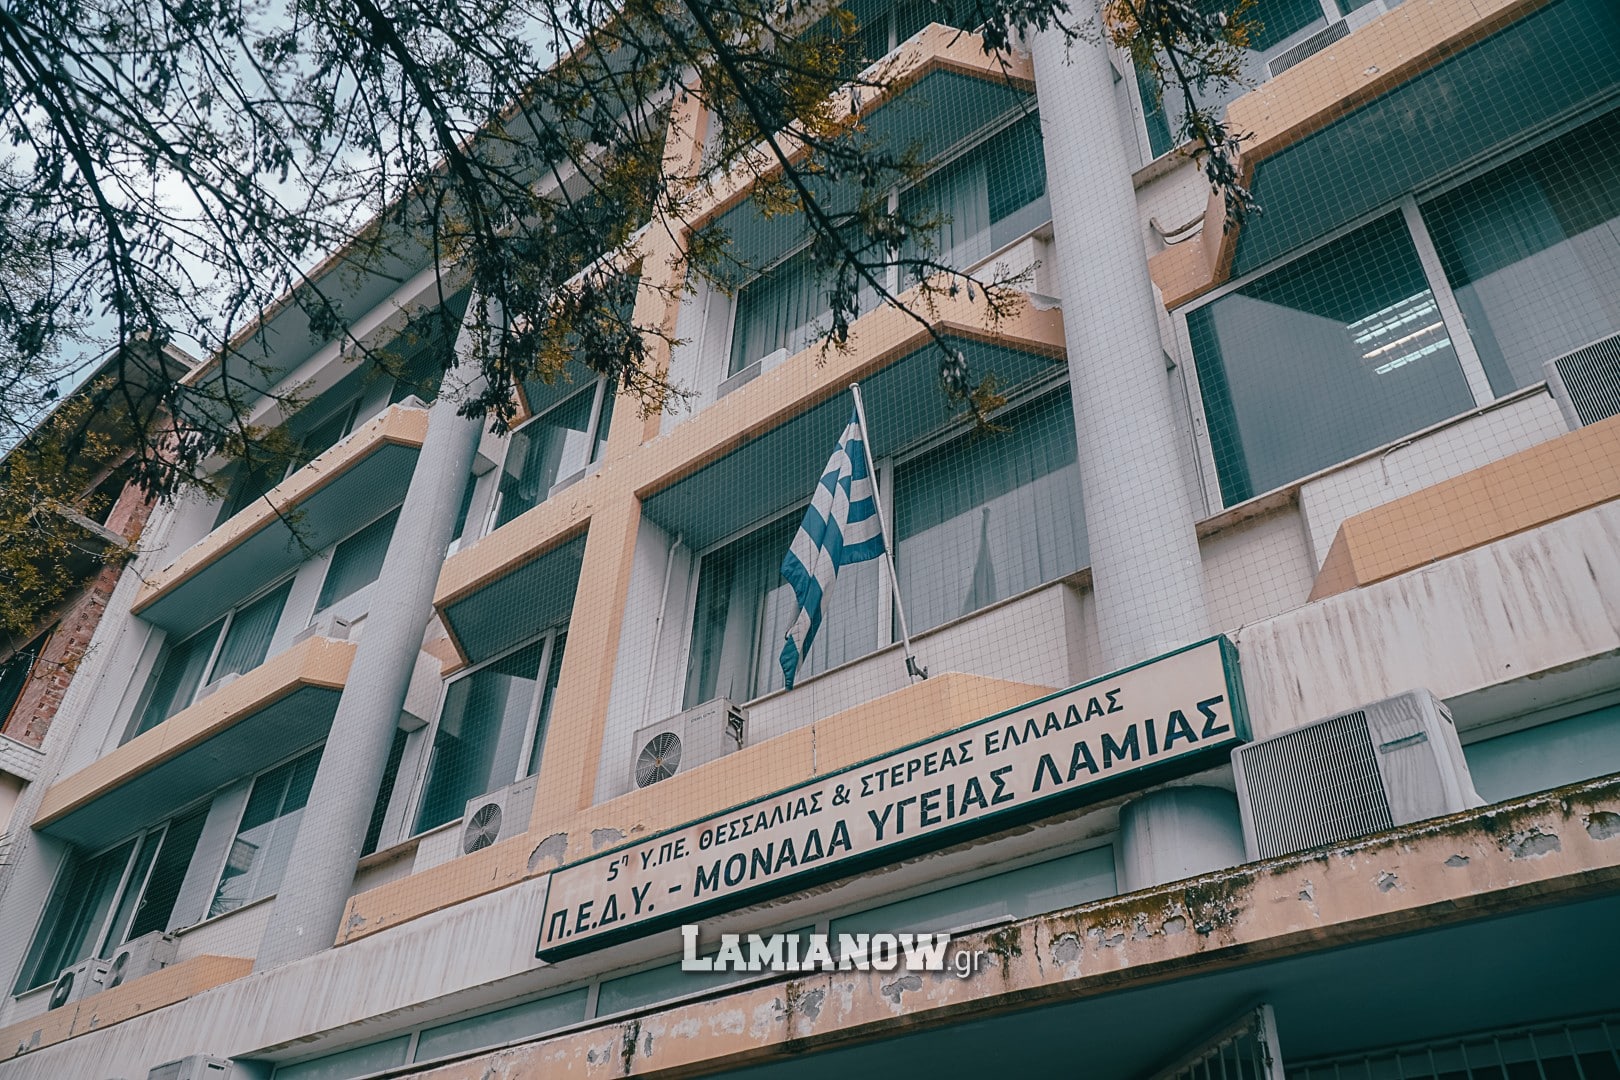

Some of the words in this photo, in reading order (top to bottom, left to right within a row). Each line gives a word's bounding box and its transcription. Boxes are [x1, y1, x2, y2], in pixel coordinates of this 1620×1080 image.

[547, 881, 655, 943] Π.Ε.Δ.Υ.
[693, 819, 853, 898] ΜΟΝΑΔΑ
[868, 764, 1015, 841] ΥΓΕΙΑΣ
[1031, 694, 1230, 793] ΛΑΜΙΑΣ
[640, 837, 690, 870] Υ.ΠΕ.
[699, 790, 824, 851] ΘΕΣΣΑΛΙΑΣ
[831, 783, 851, 806] &
[860, 739, 974, 798] ΣΤΕΡΕΑΣ
[985, 687, 1124, 756] ΕΛΛΑΔΑΣ
